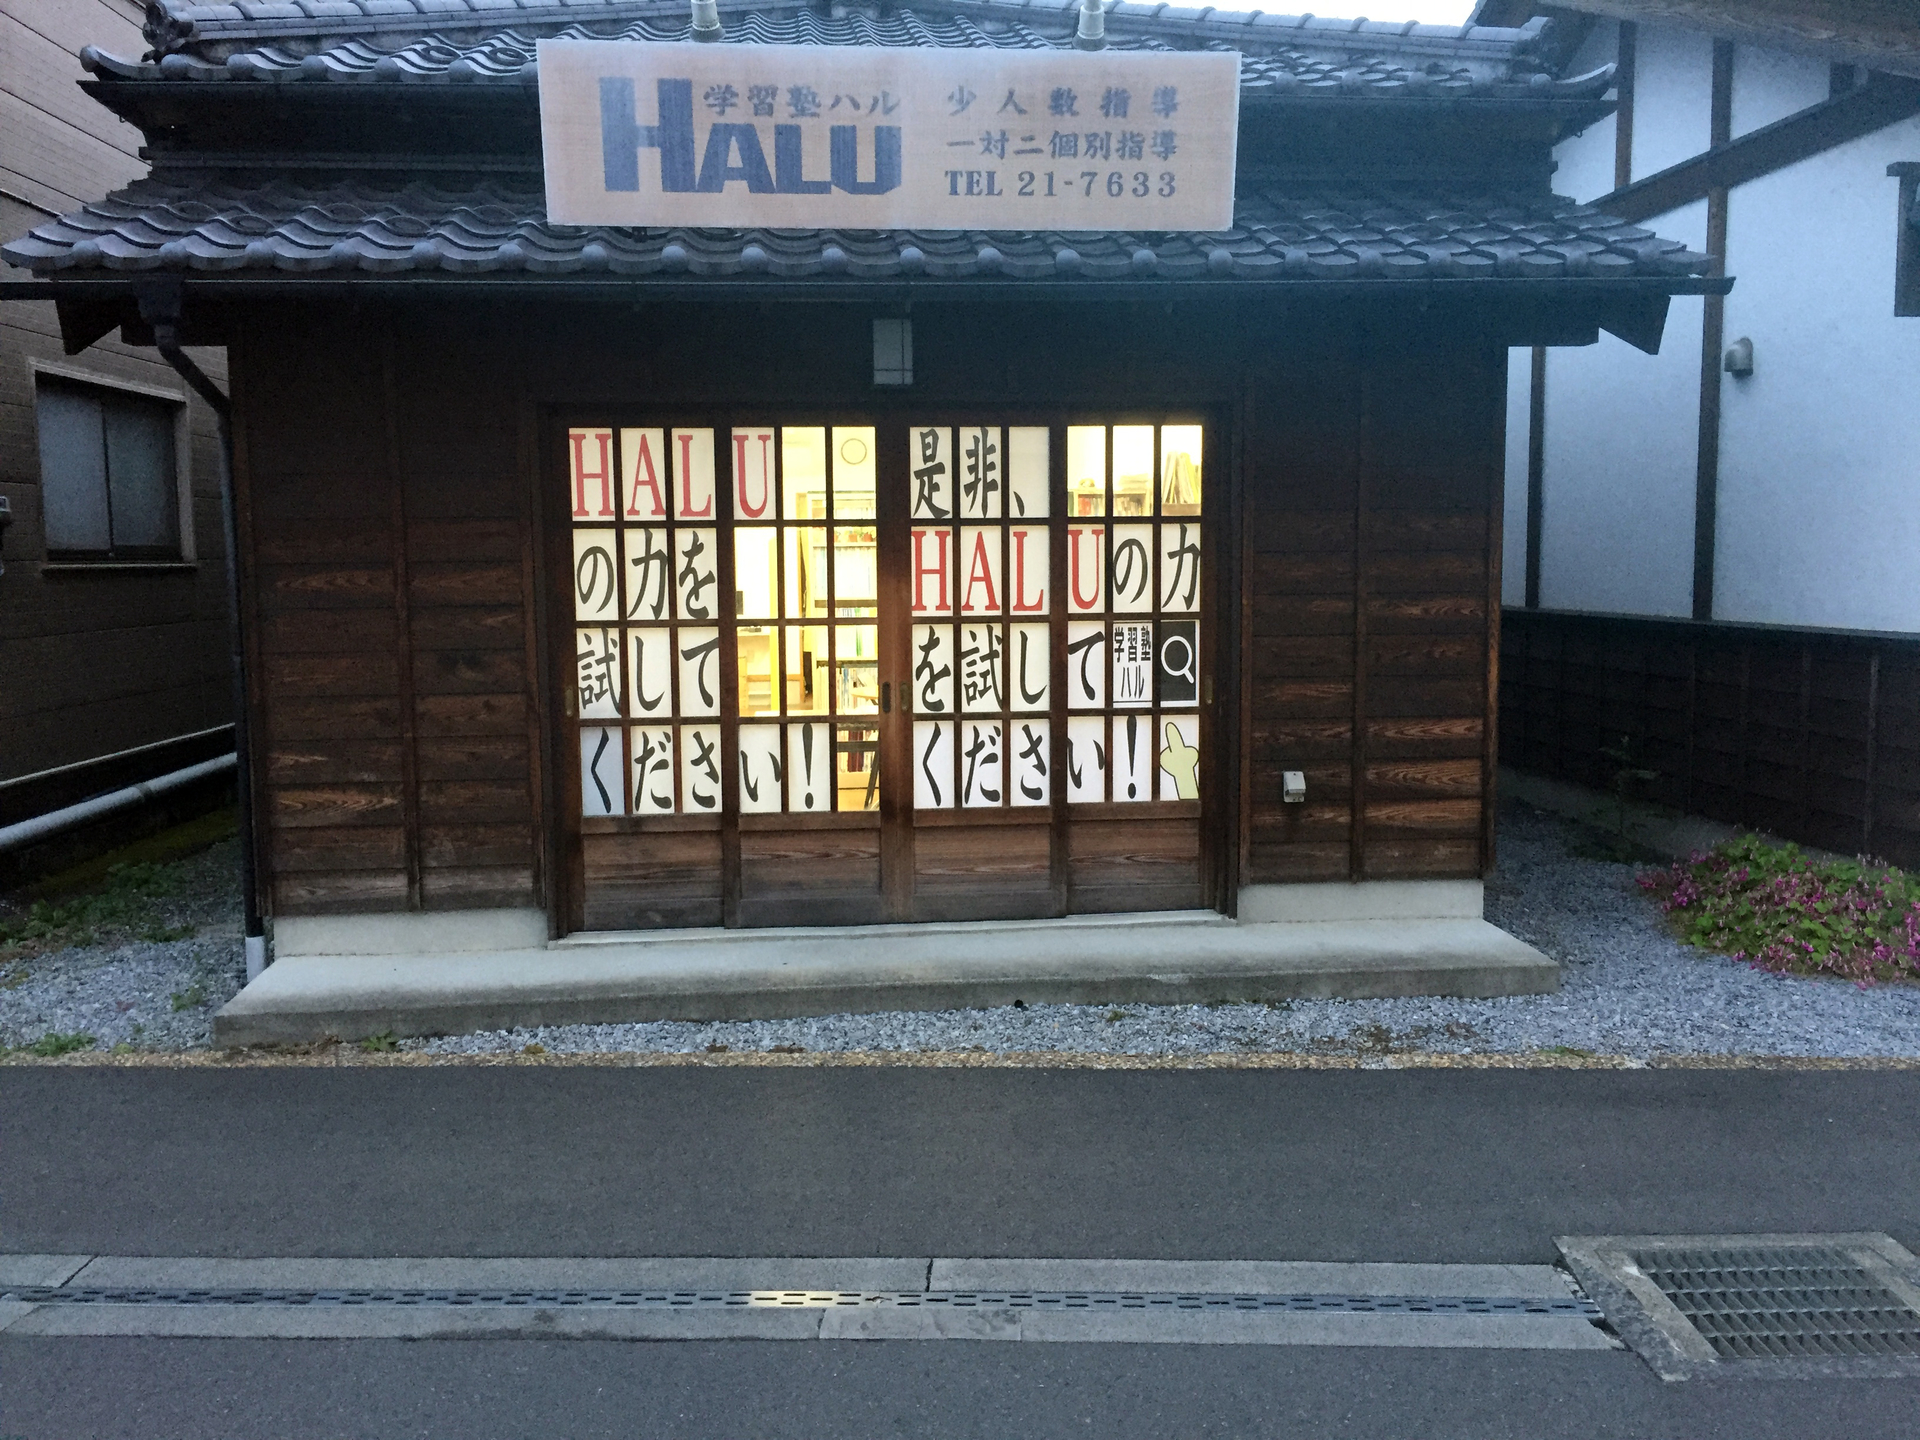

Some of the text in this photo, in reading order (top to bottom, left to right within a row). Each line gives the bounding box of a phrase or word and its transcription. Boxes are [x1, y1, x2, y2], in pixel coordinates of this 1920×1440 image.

[600, 76, 902, 196] HALU
[703, 84, 899, 118] 学習塾ハル
[947, 85, 1178, 119] 少人数指導
[945, 170, 1177, 198] TEL 21-7633
[946, 130, 1178, 161] 一対二個別指導
[569, 433, 771, 518] HALU
[913, 427, 1025, 519] 是非、
[576, 528, 716, 620] の力を
[577, 627, 719, 717] 試して
[915, 625, 1105, 712] を試して
[1114, 626, 1151, 662] 学習塾
[1121, 665, 1145, 699] ハル
[591, 723, 814, 814] ください!
[922, 715, 1138, 807] ください!
